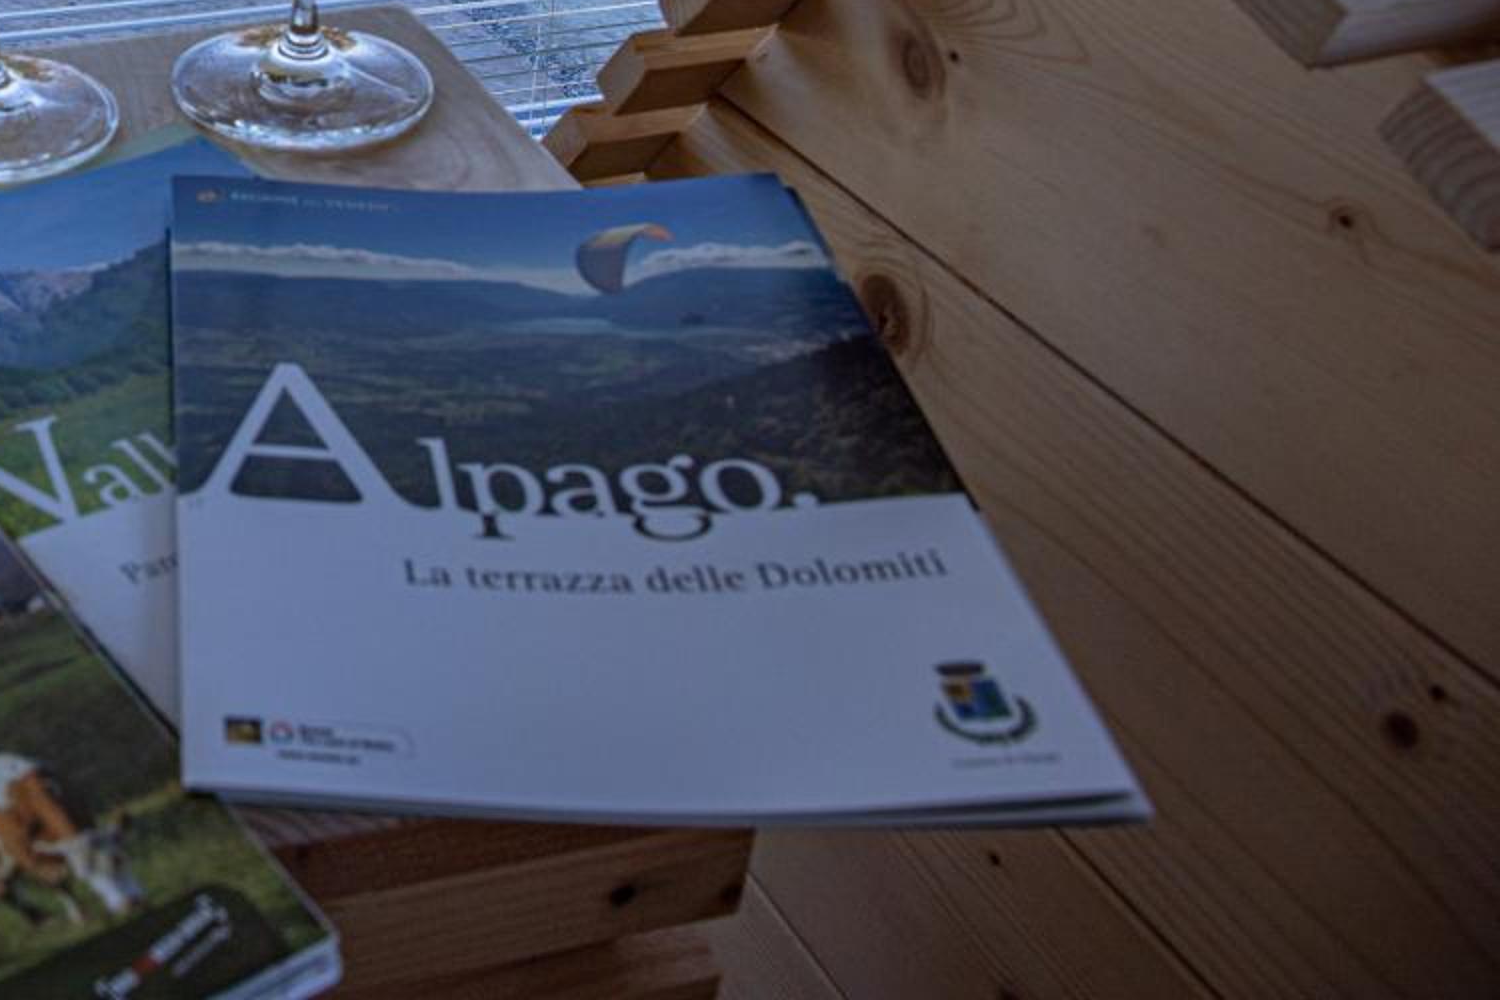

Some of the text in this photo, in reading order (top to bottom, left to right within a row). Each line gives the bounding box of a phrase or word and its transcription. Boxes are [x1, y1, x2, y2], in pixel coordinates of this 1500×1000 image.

[178, 362, 822, 541] Alpago.
[404, 547, 948, 595] La terrazza delle Dolomiti
